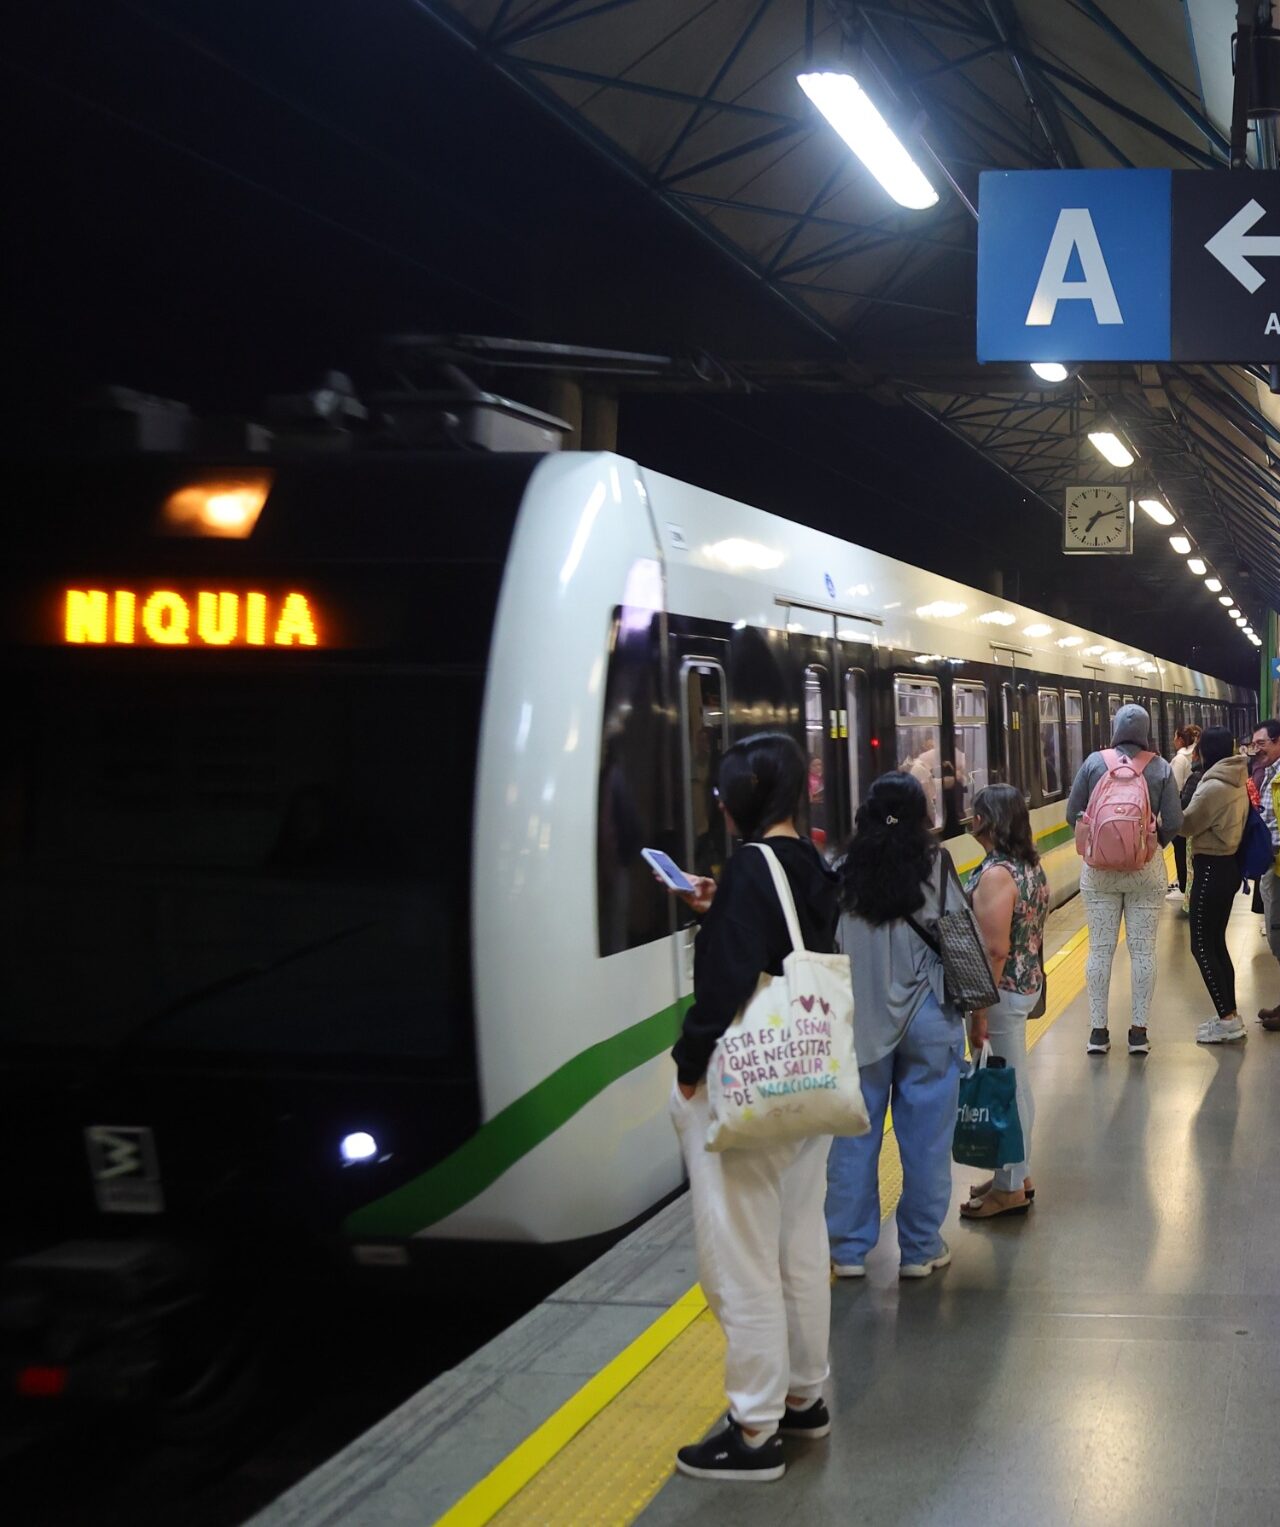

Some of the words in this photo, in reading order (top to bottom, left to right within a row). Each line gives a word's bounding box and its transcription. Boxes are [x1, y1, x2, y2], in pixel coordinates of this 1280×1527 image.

[1025, 208, 1124, 326] A
[65, 590, 318, 646] NIQUIA
[724, 1031, 756, 1054] ESTA
[759, 1028, 775, 1045] ES
[795, 1017, 832, 1038] SEÑAL
[729, 1050, 760, 1071] QUE
[764, 1039, 832, 1064] NECESITAS
[741, 1065, 779, 1086] PARA
[783, 1057, 823, 1078] SALIR
[733, 1088, 754, 1107] DE
[757, 1074, 838, 1099] VACACIONES
